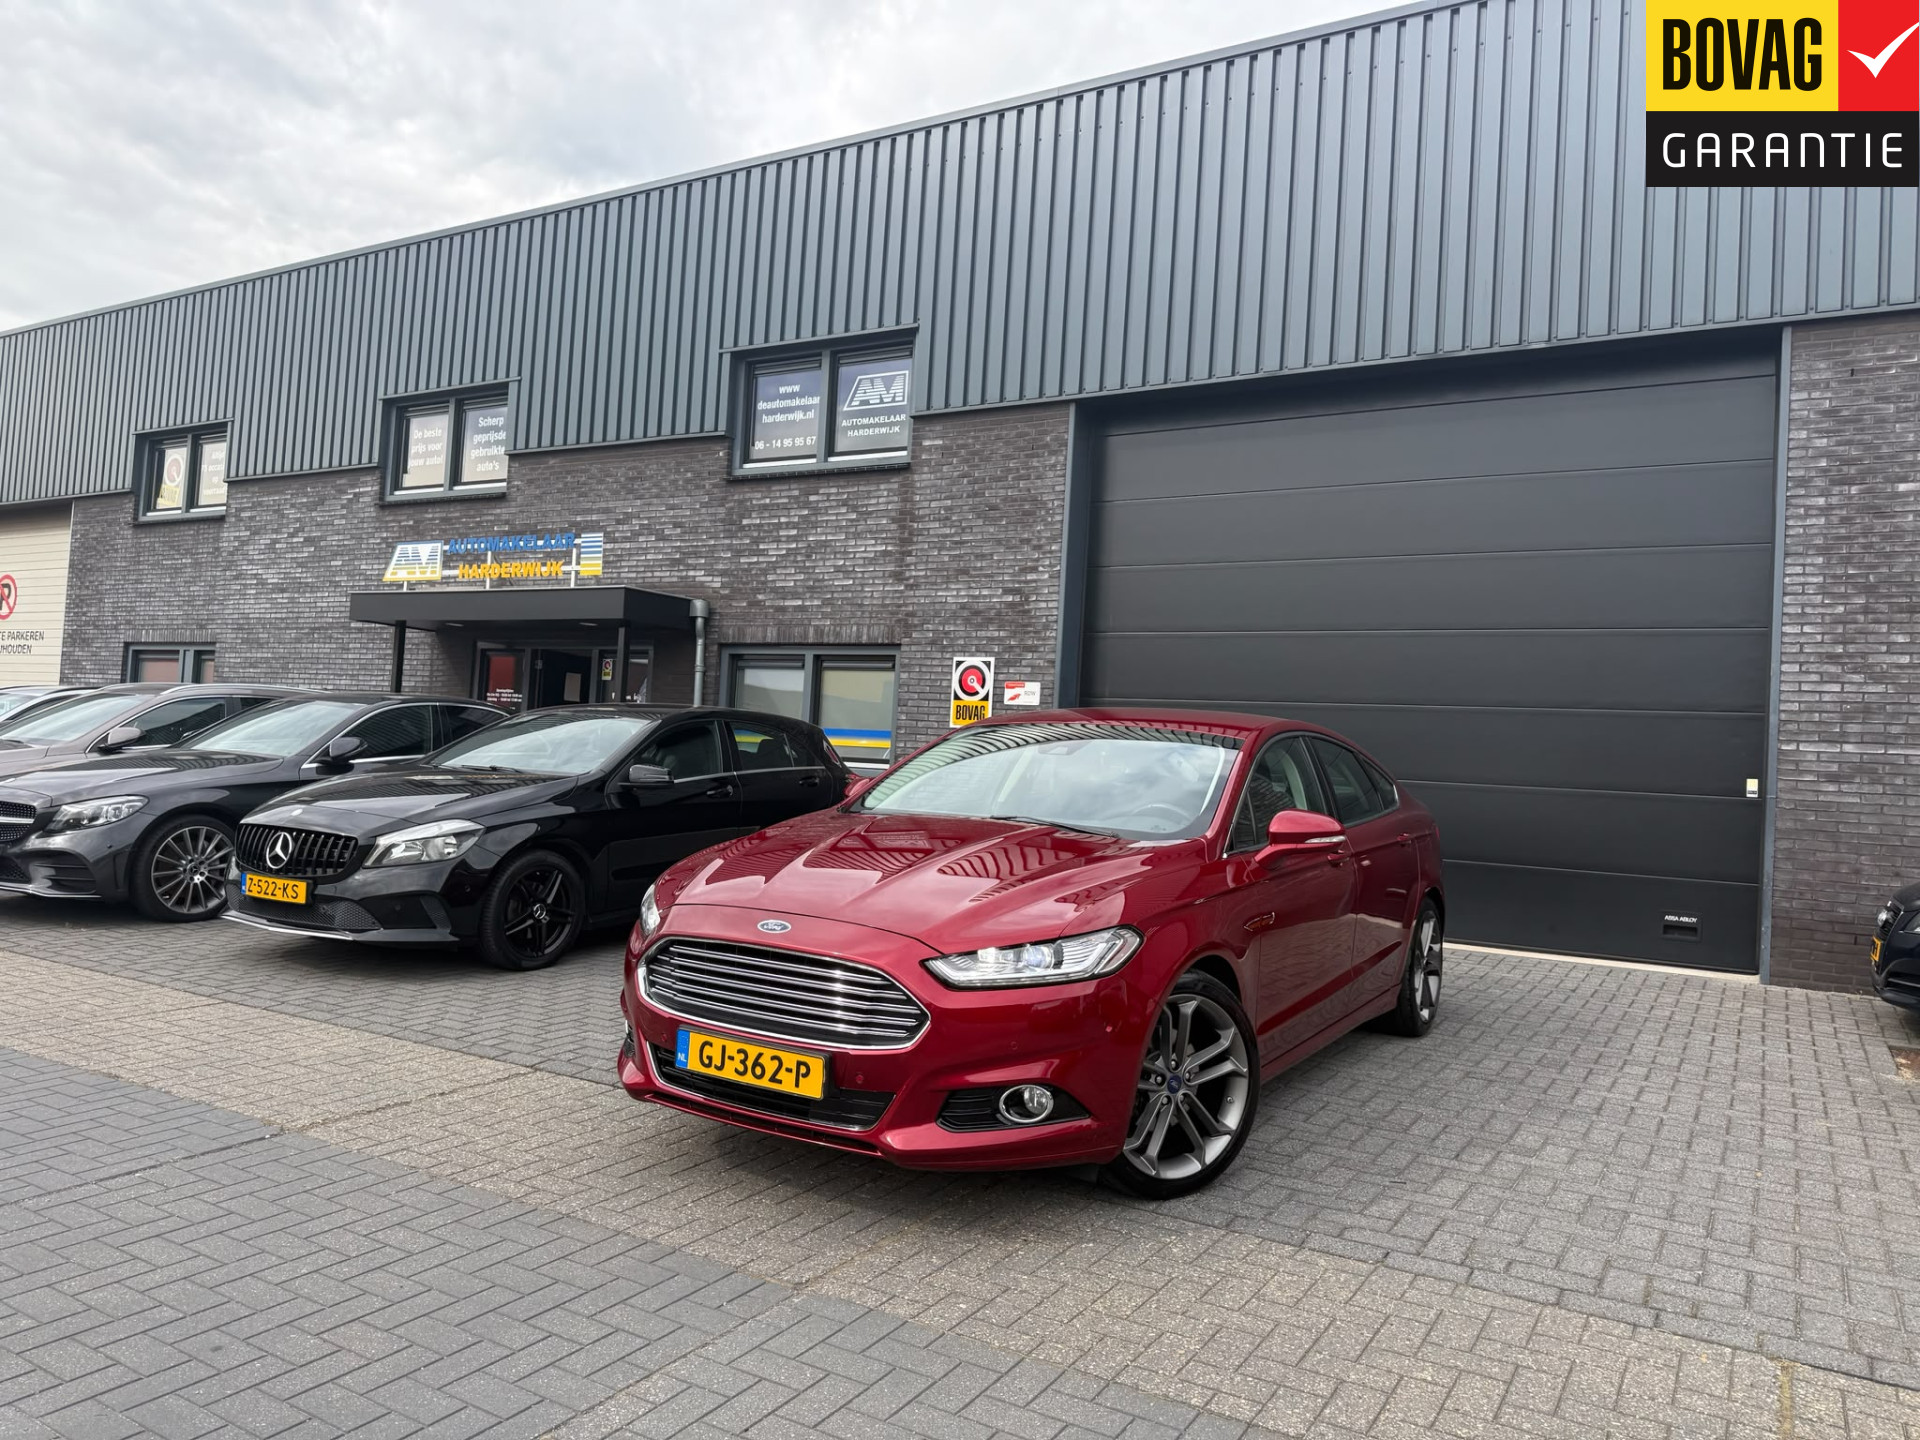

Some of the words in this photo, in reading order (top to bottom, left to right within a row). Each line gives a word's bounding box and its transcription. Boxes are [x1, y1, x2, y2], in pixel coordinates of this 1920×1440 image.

[779, 384, 800, 394] www
[757, 395, 820, 410] deautomakelaar
[478, 416, 504, 427] Scherp
[762, 409, 815, 424] harderwijk.nl
[841, 413, 906, 427] AUTOMAKELAAR
[424, 427, 442, 438] beste
[847, 425, 900, 437] HARDERWIJK
[427, 442, 443, 451] voor
[754, 440, 765, 450] 06
[772, 438, 781, 448] 14
[783, 437, 793, 447] 95
[794, 436, 804, 446] 95
[806, 435, 816, 445] 67
[471, 445, 505, 459] gebruikte
[476, 461, 500, 472] auto's
[447, 532, 576, 555] AUTOMAKELAAR
[458, 560, 564, 579] HARDERWIJK
[7, 631, 45, 641] PARKEREN
[955, 704, 986, 721] BOVAG
[248, 877, 299, 900] Z-522-KS
[698, 1040, 811, 1088] GJ-362-P
